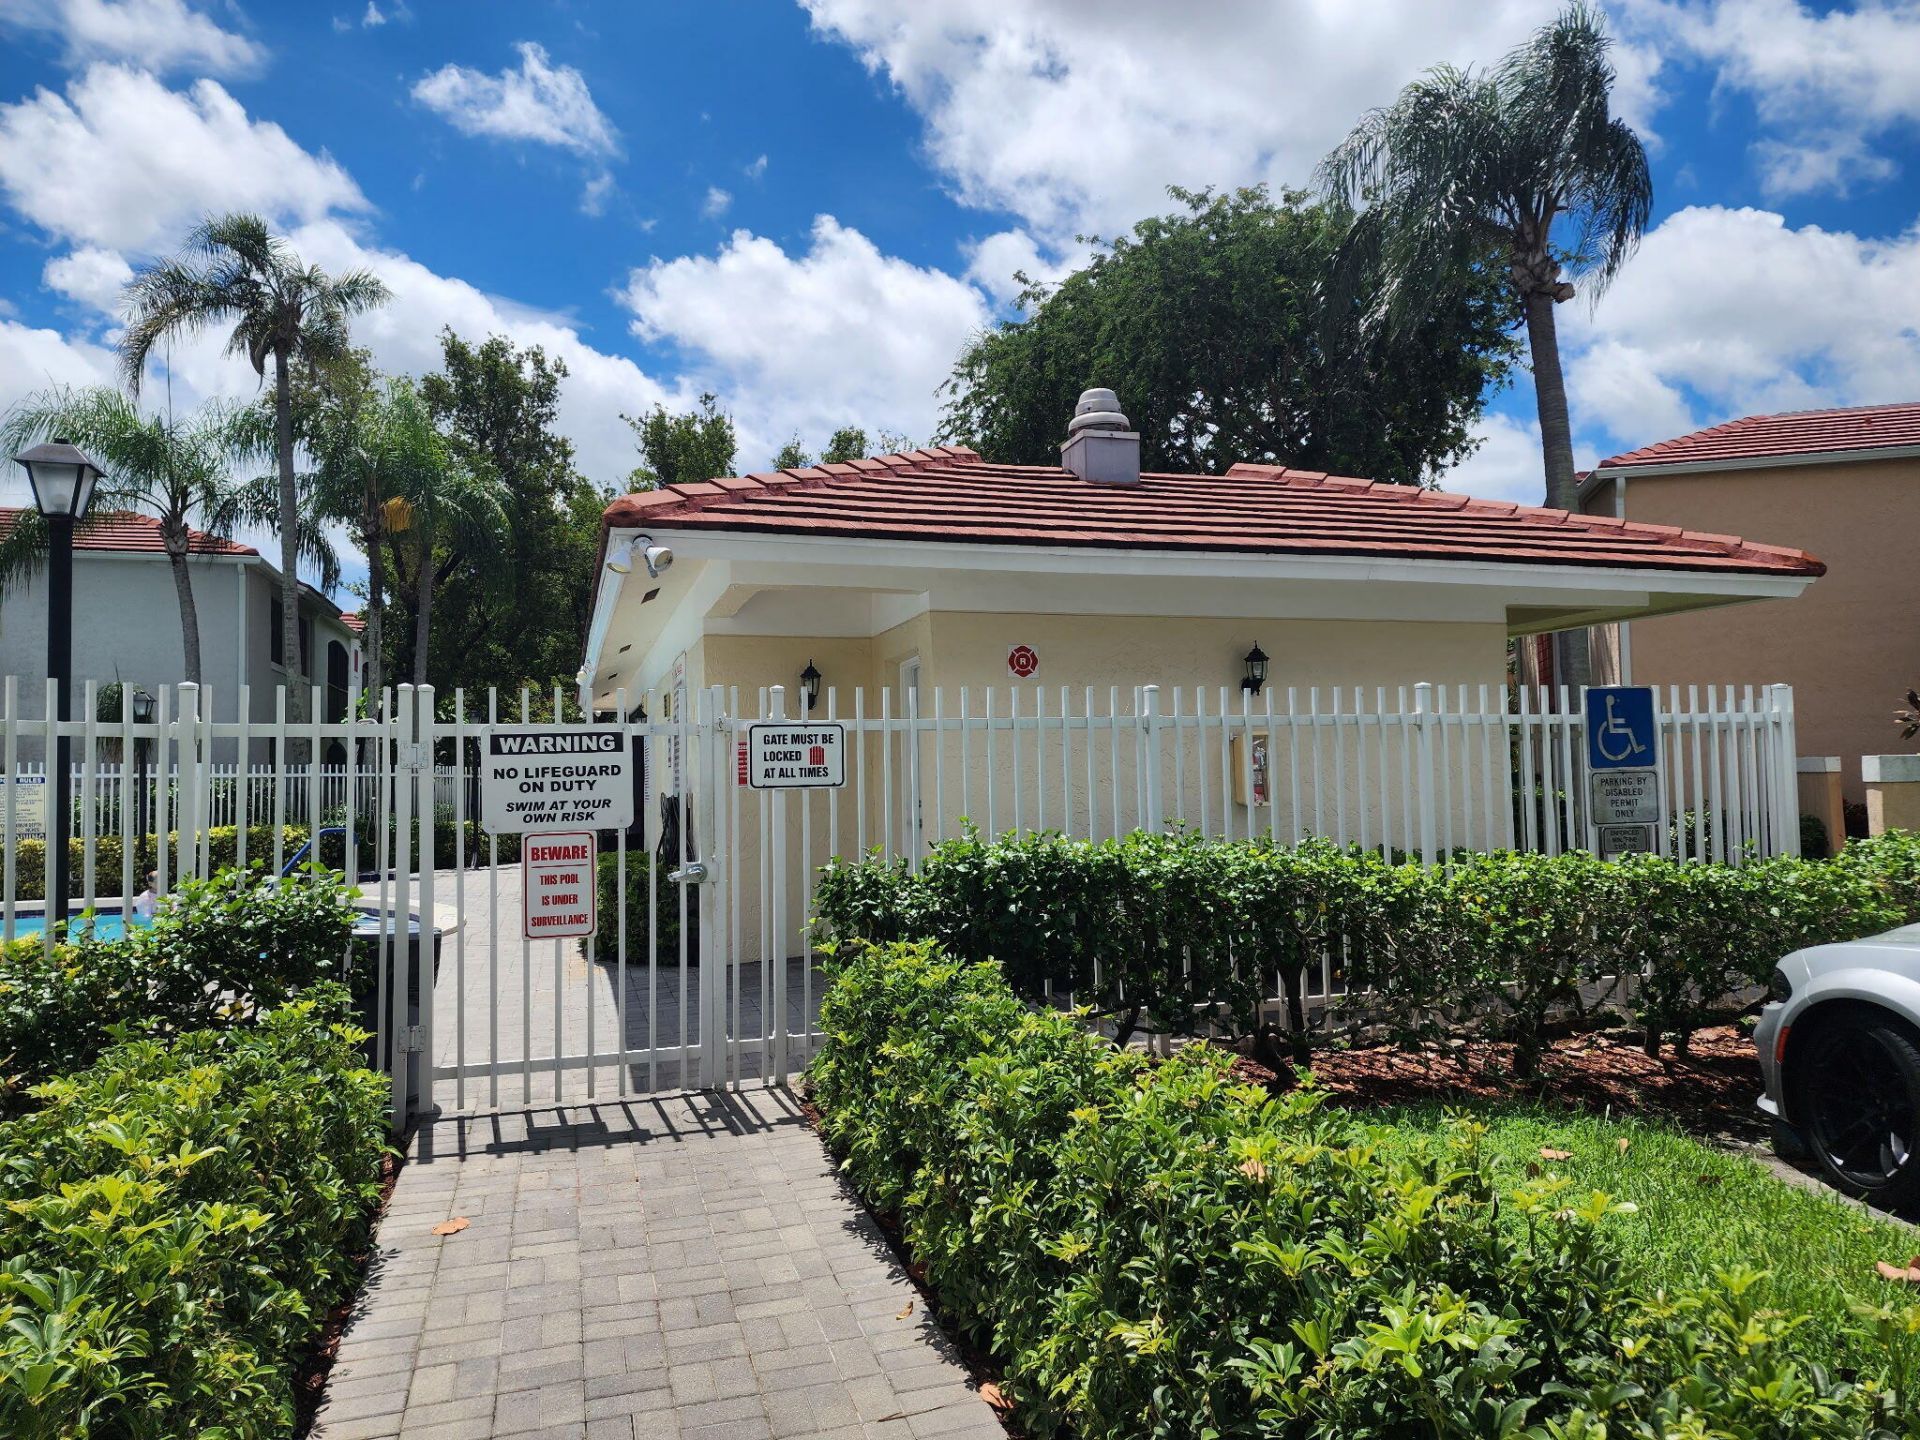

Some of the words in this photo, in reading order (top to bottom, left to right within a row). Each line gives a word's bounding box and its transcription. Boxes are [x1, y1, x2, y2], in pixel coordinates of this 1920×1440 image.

[499, 735, 616, 754] WARNING
[763, 734, 788, 745] GATE
[791, 733, 818, 744] MUST
[821, 733, 834, 744] BE
[763, 751, 802, 762] LOCKED
[493, 767, 519, 780] NO
[524, 764, 621, 779] LIFEGUARD
[763, 768, 776, 779] AT
[778, 767, 796, 778] ALL
[798, 766, 829, 778] TIMES
[519, 780, 544, 793] ON
[550, 779, 597, 792] DUTY
[1600, 777, 1633, 786] PARKING
[1637, 776, 1647, 785] BY
[1605, 788, 1643, 797] DISABLED
[506, 801, 545, 812] SWIM
[549, 800, 568, 811] AT
[573, 798, 611, 809] YOUR
[1610, 798, 1639, 807] PERMIT
[523, 812, 558, 824] OWN
[561, 811, 596, 822] RISK
[1615, 809, 1635, 817] ONLY
[531, 845, 588, 861] BEWARE
[540, 874, 558, 886] THIS
[560, 873, 580, 884] POOL
[541, 895, 550, 906] IS
[552, 894, 578, 905] UNDER
[531, 913, 589, 927] SURVEILLANCE
